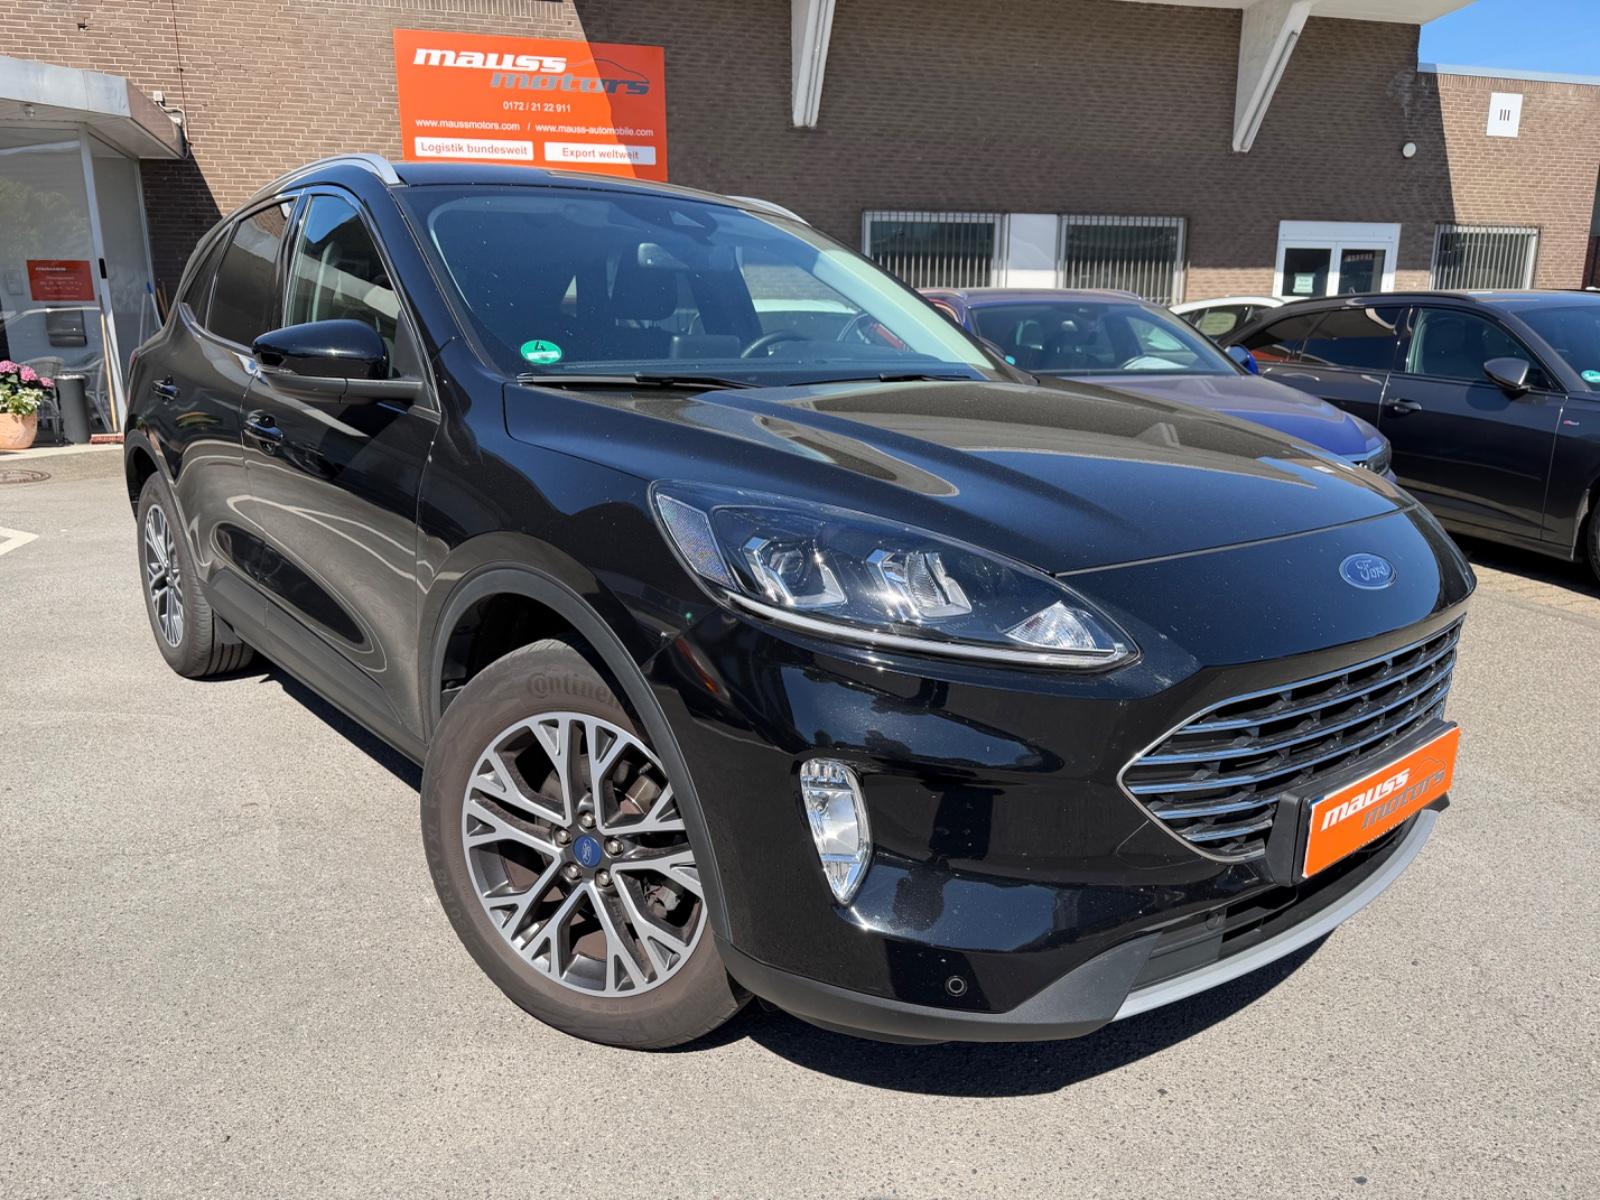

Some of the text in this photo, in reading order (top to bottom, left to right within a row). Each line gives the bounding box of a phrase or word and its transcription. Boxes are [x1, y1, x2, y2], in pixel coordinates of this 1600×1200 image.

[413, 48, 567, 73] mauss
[490, 72, 649, 95] motors
[503, 101, 524, 111] 0172
[531, 102, 541, 112] 21
[544, 103, 554, 113] 22
[556, 103, 571, 113] 911
[415, 119, 520, 131] www.maussmotors.com
[535, 124, 654, 137] www.mauss-automobile.com
[421, 142, 527, 156] Logistik bundesweit
[562, 148, 639, 160] Export weltweit
[1355, 559, 1390, 581] Ford
[1320, 768, 1411, 832] mauss
[1361, 769, 1445, 830] motors
